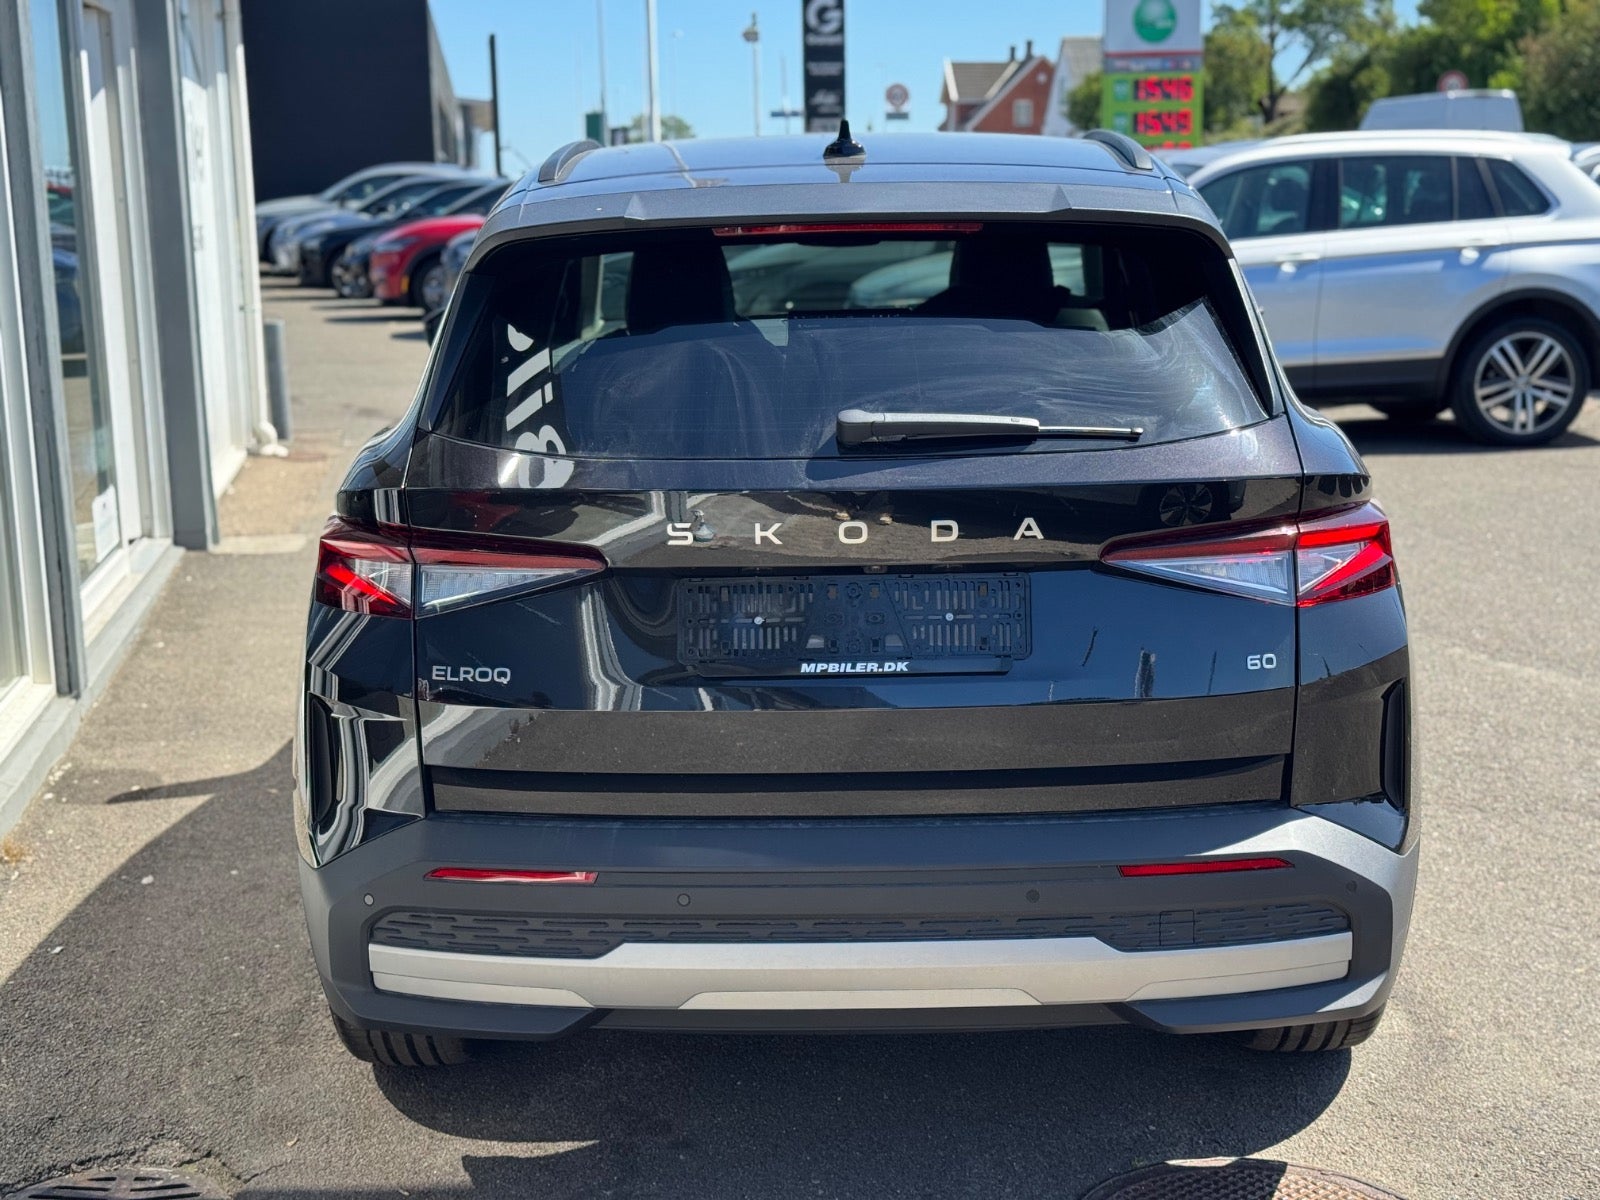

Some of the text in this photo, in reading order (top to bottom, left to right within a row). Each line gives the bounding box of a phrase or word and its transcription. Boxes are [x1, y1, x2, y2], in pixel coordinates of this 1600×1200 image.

[800, 661, 910, 674] MPBILER.DK
[1246, 653, 1277, 670] 60
[431, 665, 511, 684] ELROQ
